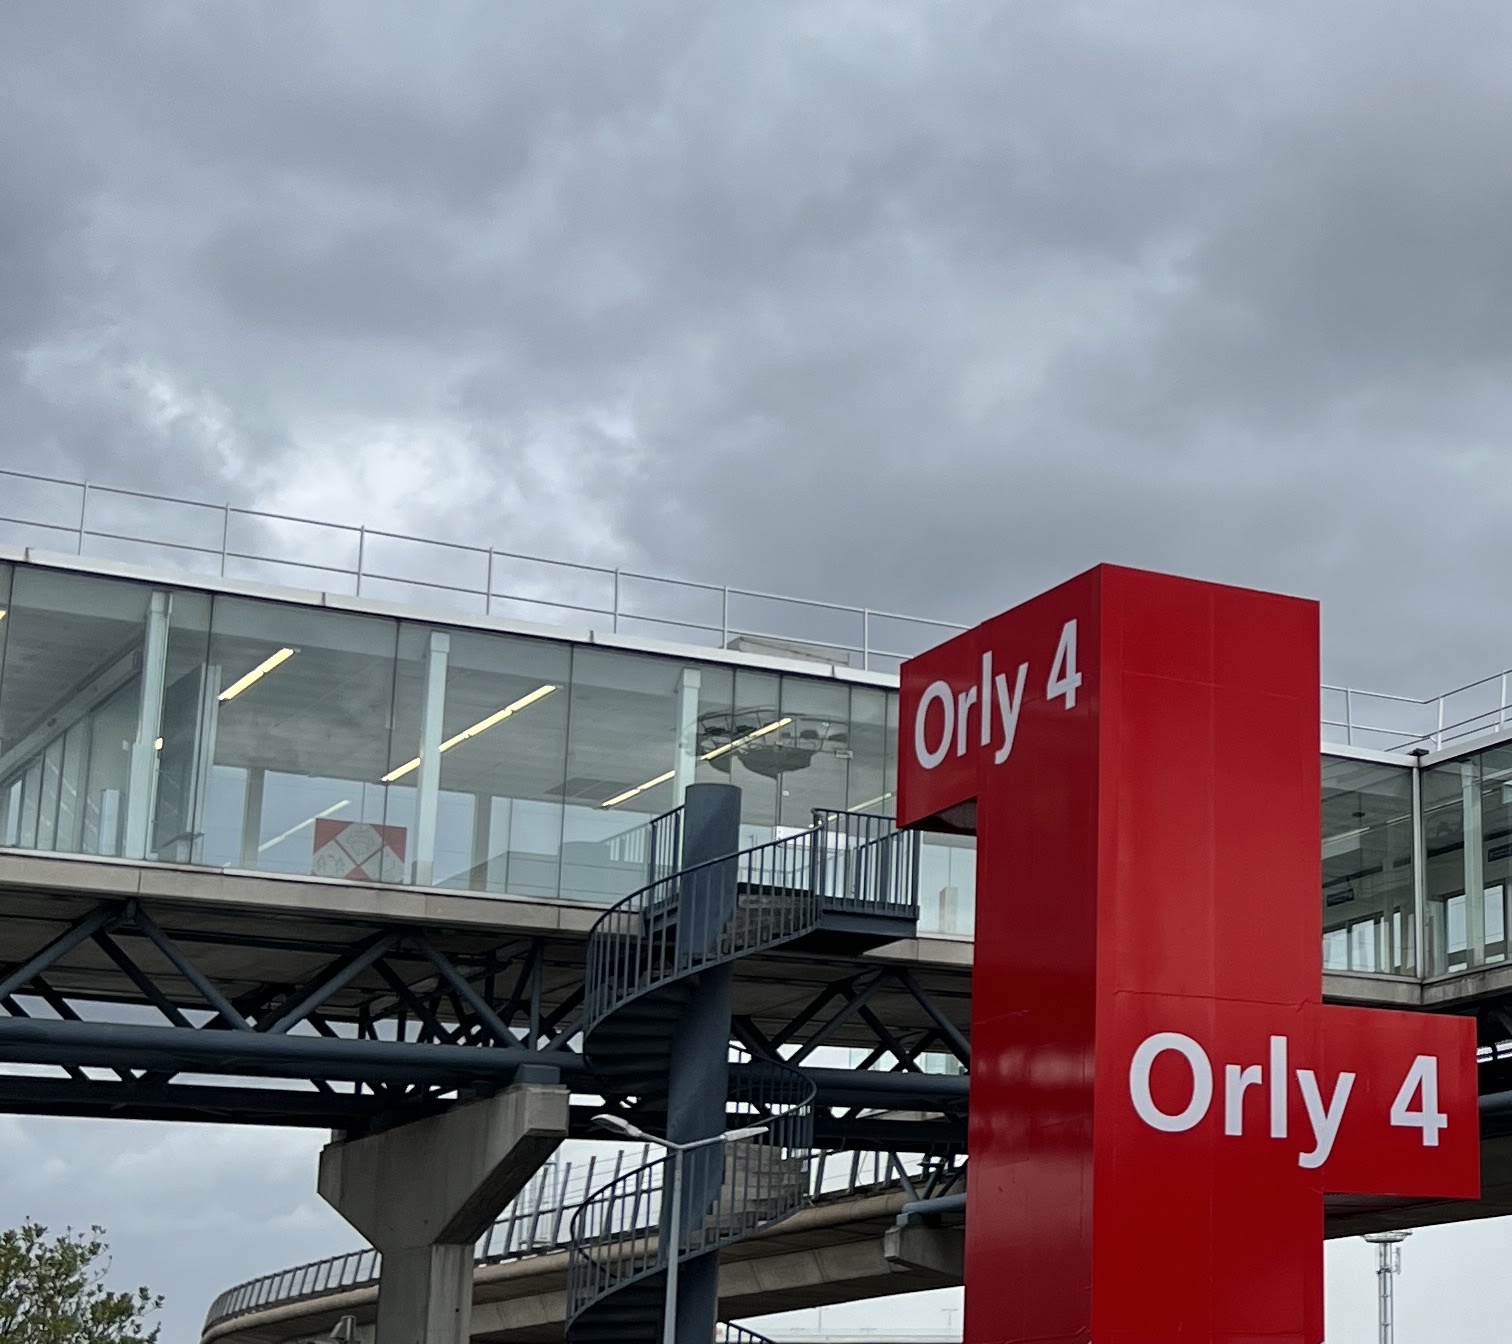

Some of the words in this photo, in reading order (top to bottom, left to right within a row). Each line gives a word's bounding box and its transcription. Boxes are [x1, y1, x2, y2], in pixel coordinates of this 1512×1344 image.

[914, 650, 1028, 769] Orly
[1047, 619, 1082, 710] 4
[1129, 1032, 1356, 1169] Orly
[1390, 1054, 1448, 1147] 4
